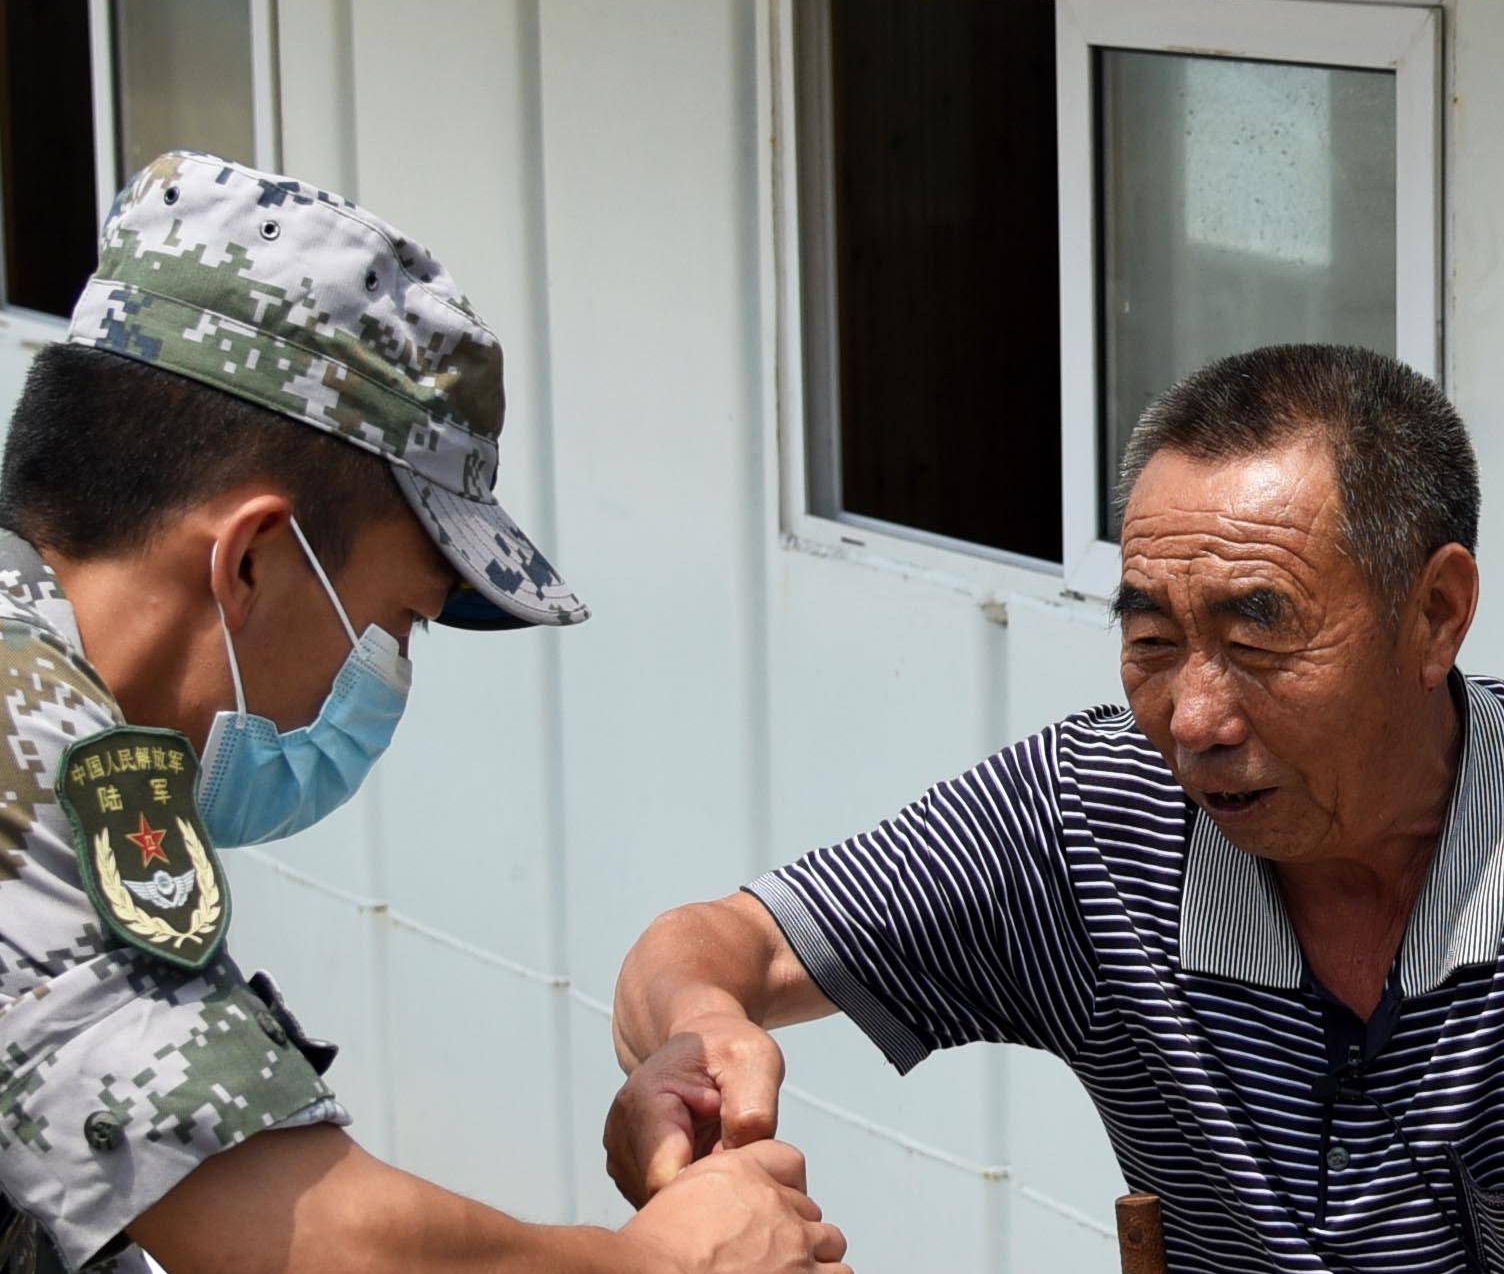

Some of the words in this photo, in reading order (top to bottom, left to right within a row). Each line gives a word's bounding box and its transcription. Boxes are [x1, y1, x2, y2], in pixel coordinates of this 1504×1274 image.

[71, 747, 185, 787] 中国人民解放军
